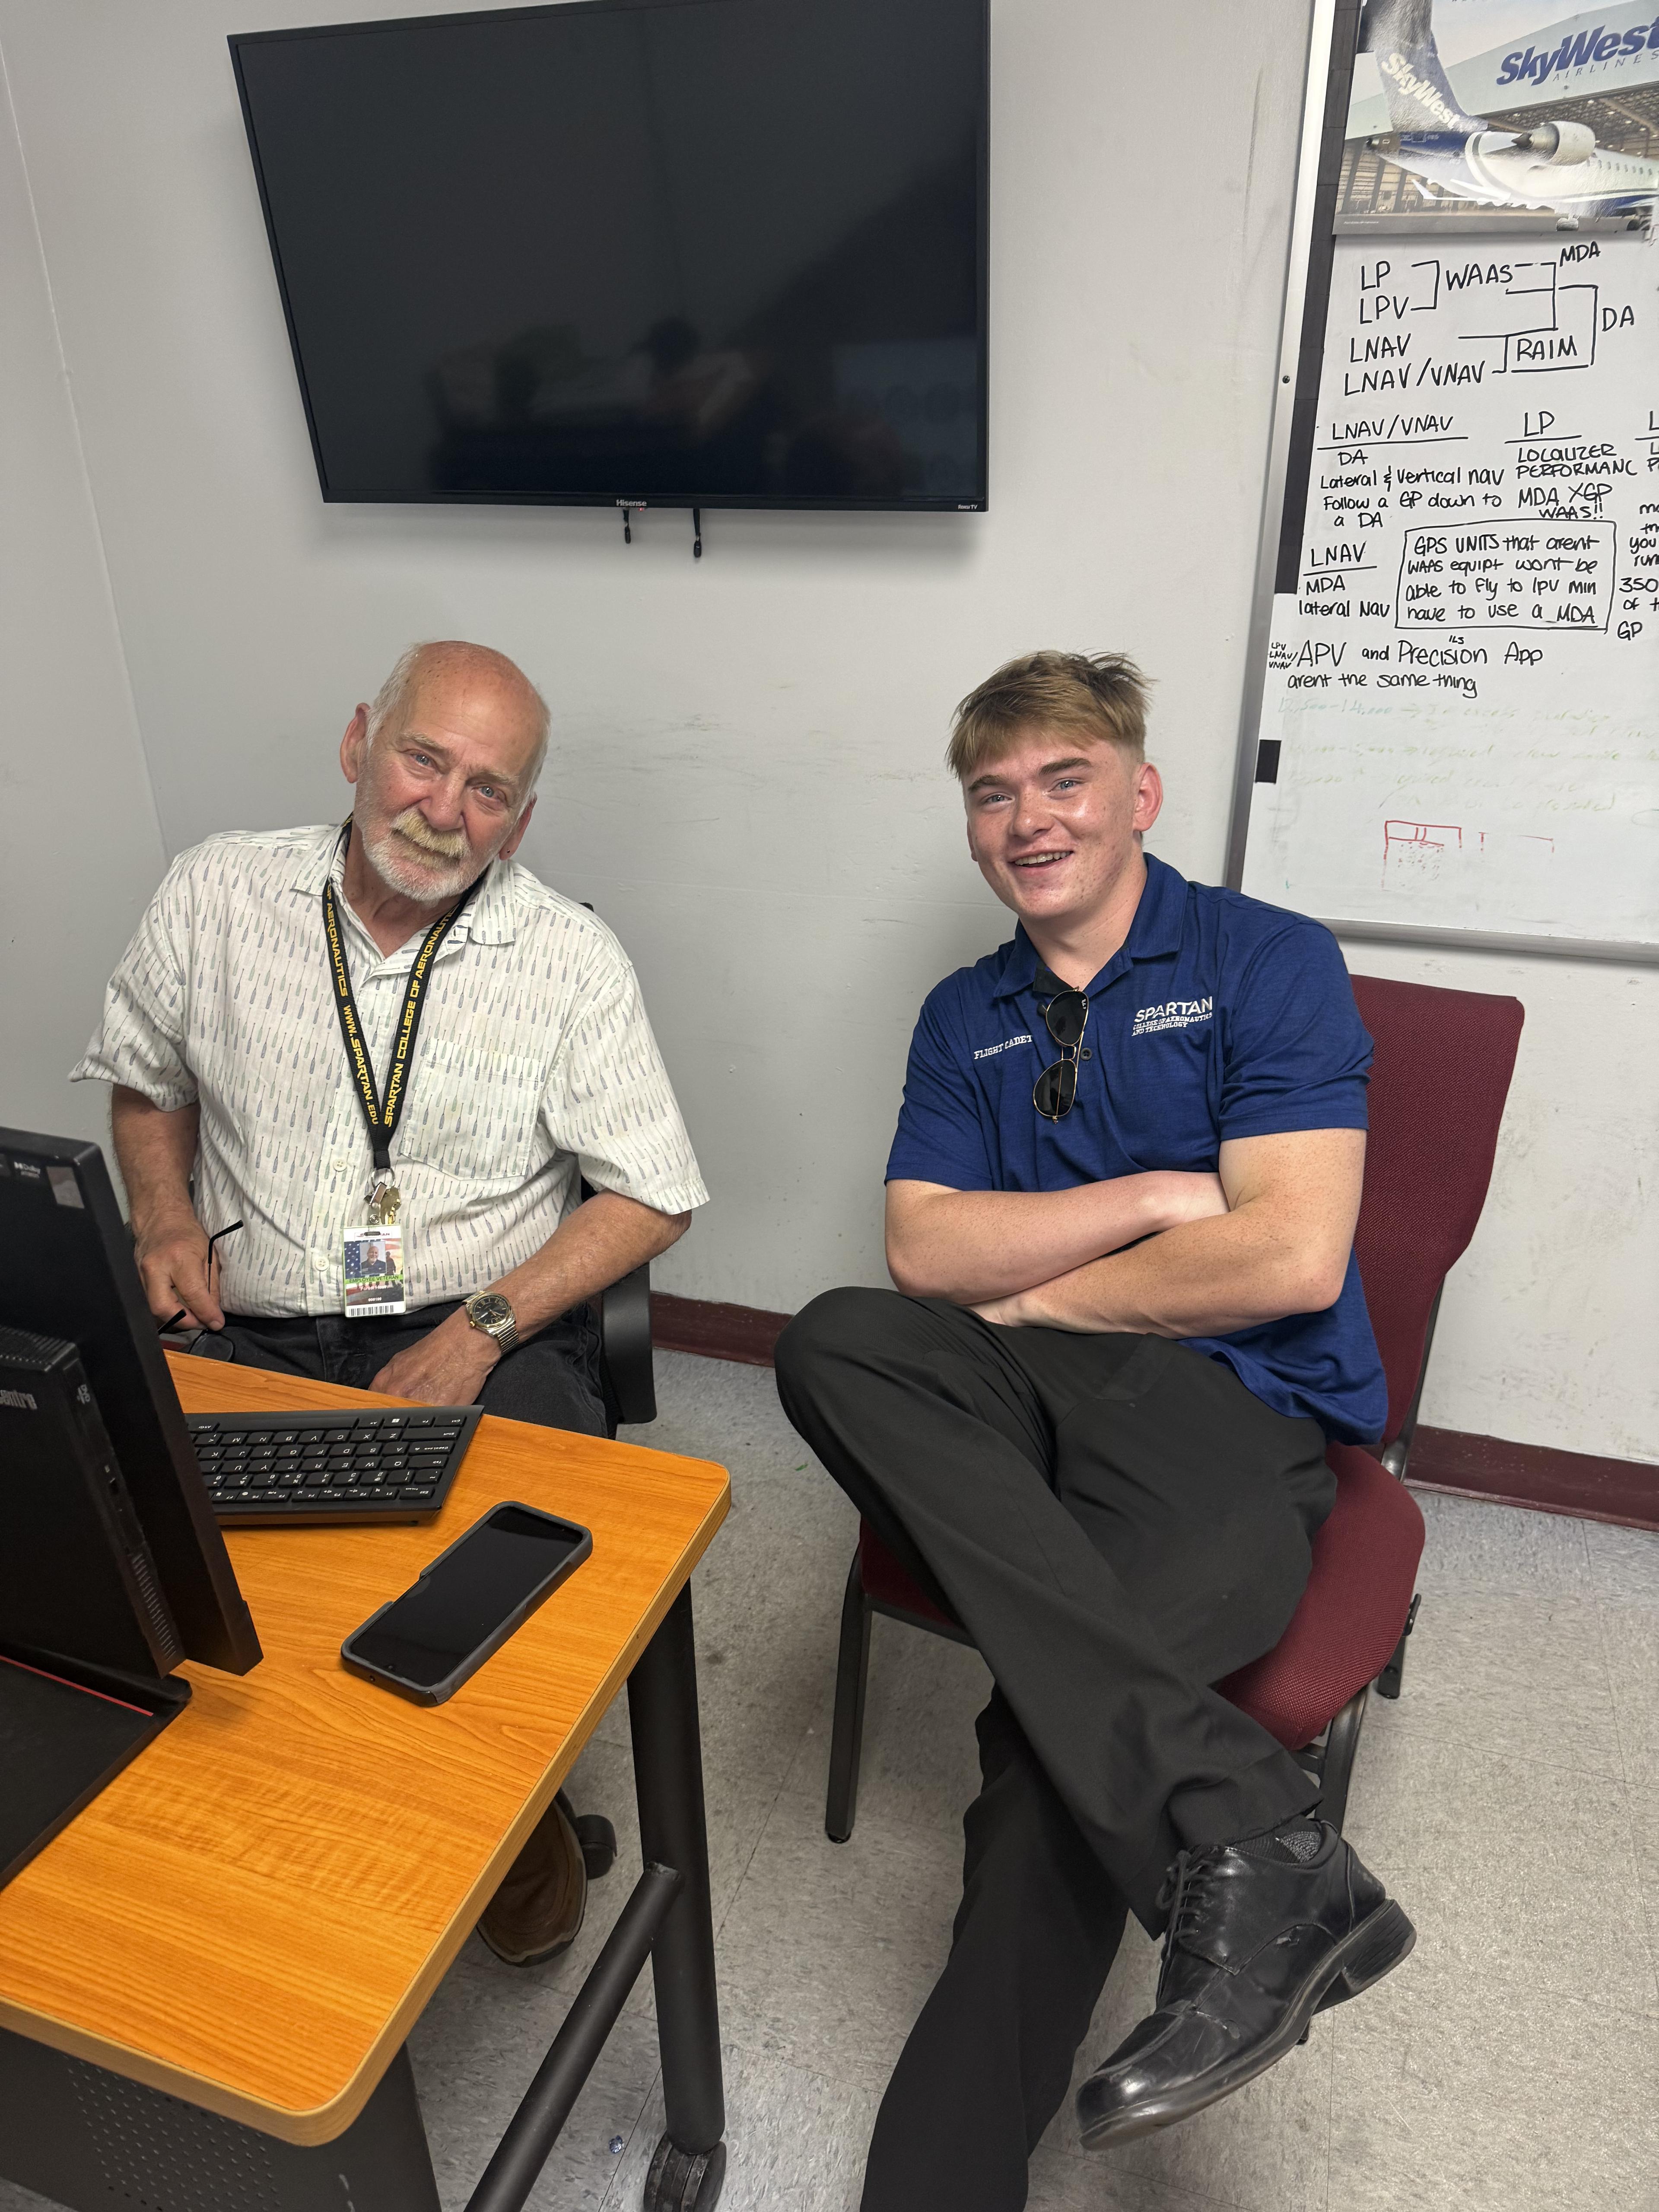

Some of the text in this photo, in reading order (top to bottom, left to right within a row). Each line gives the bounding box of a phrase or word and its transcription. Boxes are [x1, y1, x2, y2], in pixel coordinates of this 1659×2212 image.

[1497, 16, 1659, 86] SkyWest
[1552, 50, 1659, 82] AIRLINES
[1382, 52, 1461, 129] SkyWest
[1560, 241, 1601, 267] MDA
[1361, 261, 1390, 291] LP
[1446, 264, 1513, 291] WAAS
[1360, 296, 1409, 324] LPV
[1602, 305, 1635, 332] DA
[1350, 334, 1411, 363] LNAV
[1517, 335, 1578, 362] RAIM
[1524, 411, 1555, 437] LP
[1338, 449, 1368, 466] DA
[1321, 470, 1377, 489] Lateral
[1468, 469, 1505, 486] nav
[1323, 491, 1502, 511] Follow a GP down to
[1518, 487, 1560, 509] MDA
[1333, 512, 1383, 528] a DA
[1311, 540, 1367, 567] LNAV
[1414, 536, 1447, 556] GPS
[1502, 535, 1540, 551] that
[1546, 535, 1600, 551] arent
[1630, 537, 1656, 554] you
[1408, 559, 1444, 575] WAAS
[1515, 557, 1574, 571] wont
[1575, 558, 1598, 574] be
[1306, 575, 1346, 596] MDA
[1406, 583, 1442, 601] able
[1448, 580, 1467, 594] to
[1506, 577, 1523, 593] to
[1299, 600, 1350, 617] lateral
[1407, 603, 1595, 623] have to use a MDA
[1449, 635, 1465, 645] ILS
[1617, 620, 1643, 641] GP
[1271, 642, 1287, 651] LPV
[1297, 639, 1544, 667] APV and Precision App
[1287, 673, 1478, 699] arent the same thing
[327, 903, 349, 997] AERONAUTICS
[1133, 1019, 1158, 1030] COLLEGE
[1165, 1012, 1213, 1023] AERONAUTICS
[1134, 996, 1213, 1023] SPARTAN
[1144, 1021, 1189, 1033] TECHNOLOGY
[385, 1063, 404, 1128] SPARTAN
[397, 1000, 416, 1059] COLLEGE
[410, 979, 420, 998] OF
[974, 1035, 1033, 1059] FLIGHT CADET
